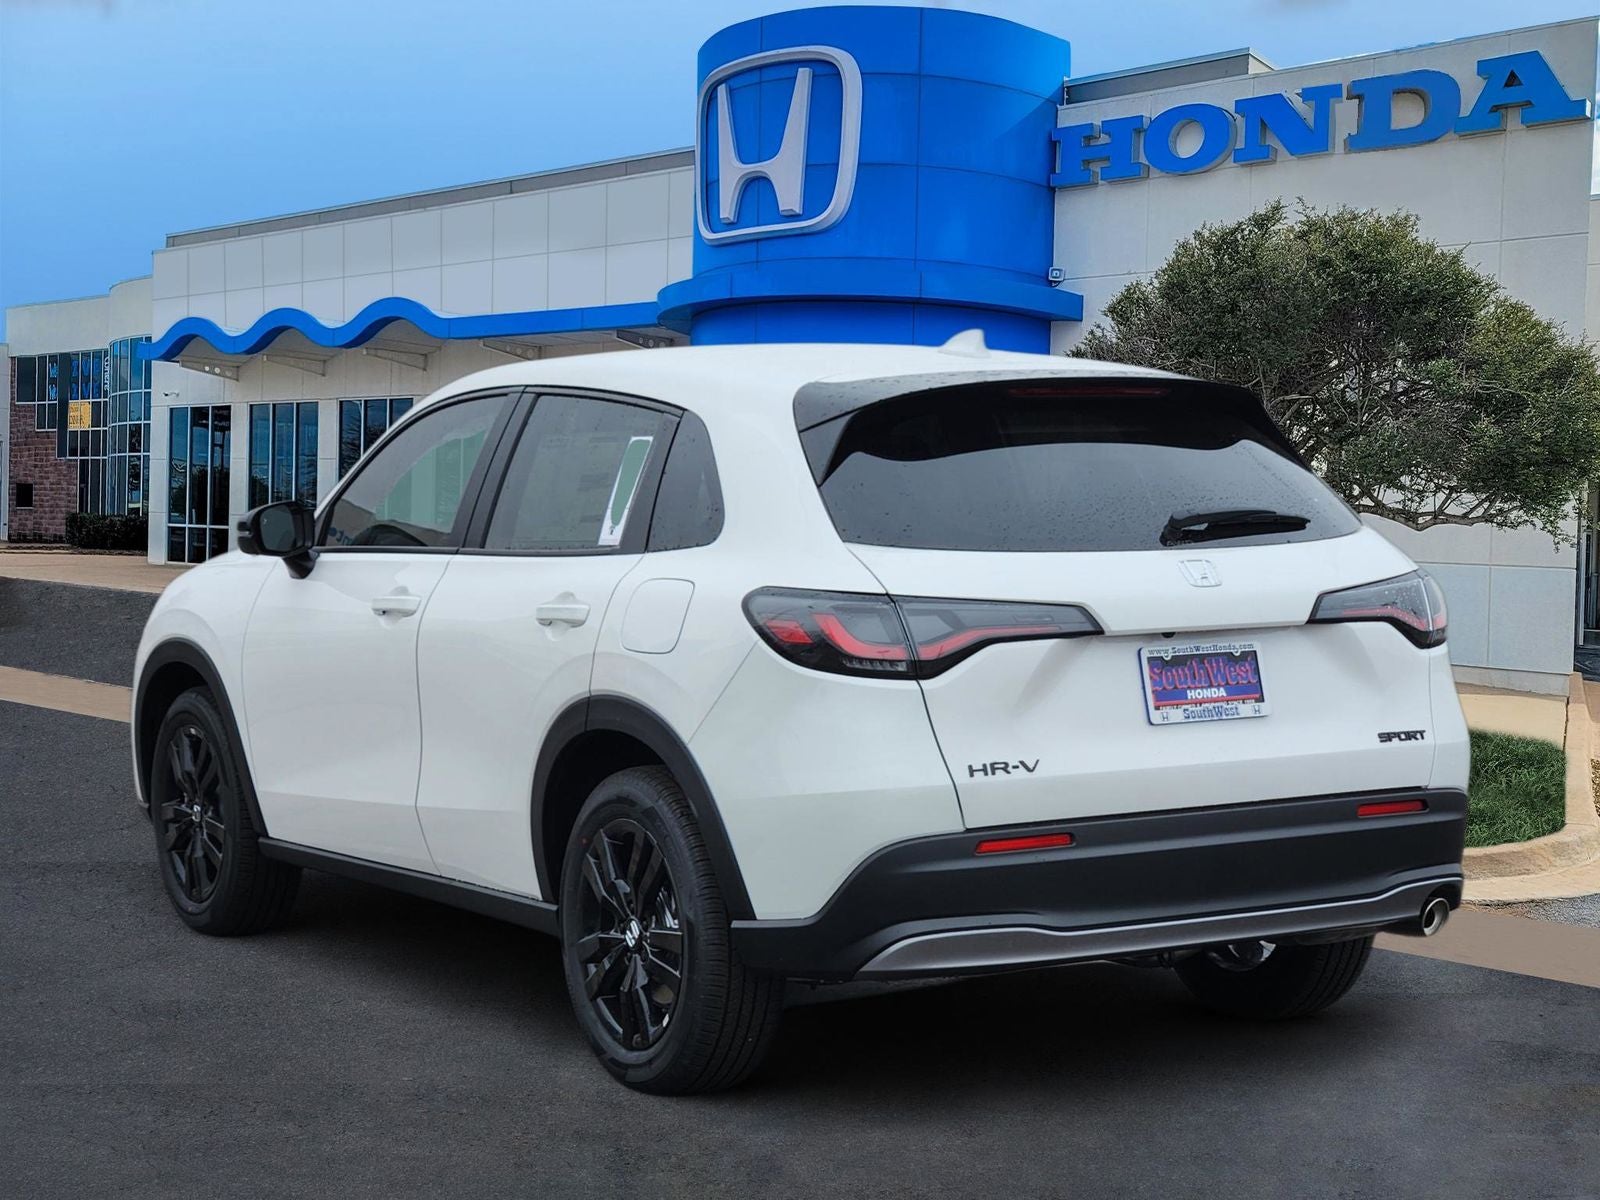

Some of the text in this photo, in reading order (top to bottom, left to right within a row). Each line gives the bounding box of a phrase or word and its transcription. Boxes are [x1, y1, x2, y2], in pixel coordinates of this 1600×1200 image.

[1051, 50, 1591, 188] HONDA
[1148, 655, 1259, 690] SouthWest
[1186, 688, 1227, 700] HONDA
[1183, 706, 1240, 720] SouthWest
[1377, 729, 1426, 743] SPORT
[967, 759, 1040, 778] HR-V
